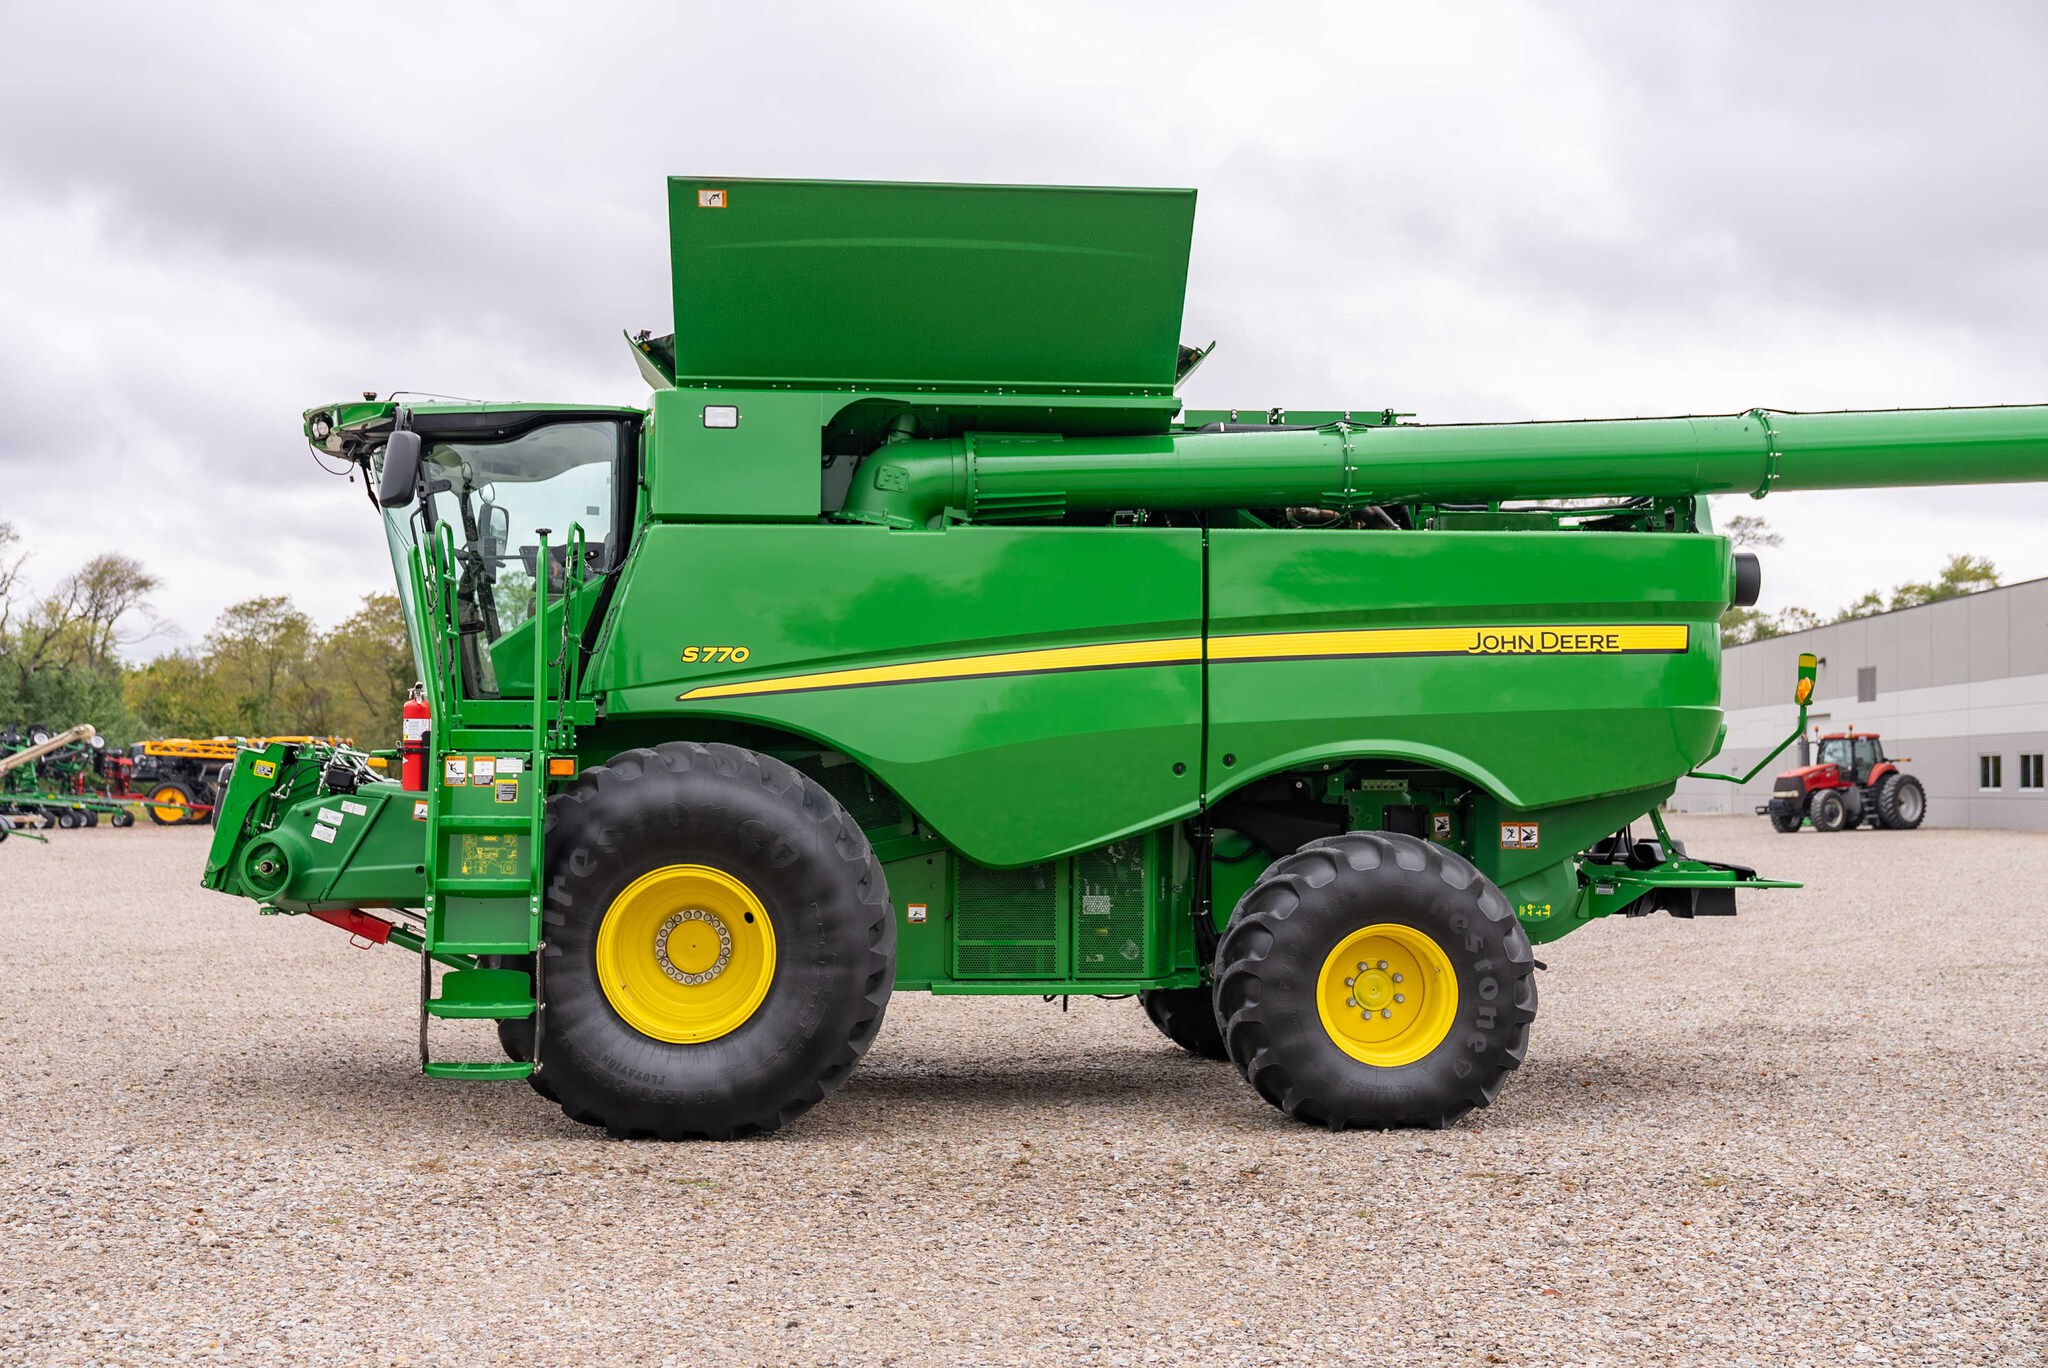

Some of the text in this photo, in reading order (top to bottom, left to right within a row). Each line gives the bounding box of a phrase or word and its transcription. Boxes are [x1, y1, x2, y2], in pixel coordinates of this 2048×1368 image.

[1468, 631, 1620, 650] JOHN DEERE
[681, 646, 750, 663] S770
[601, 1054, 667, 1085] FLOTATION
